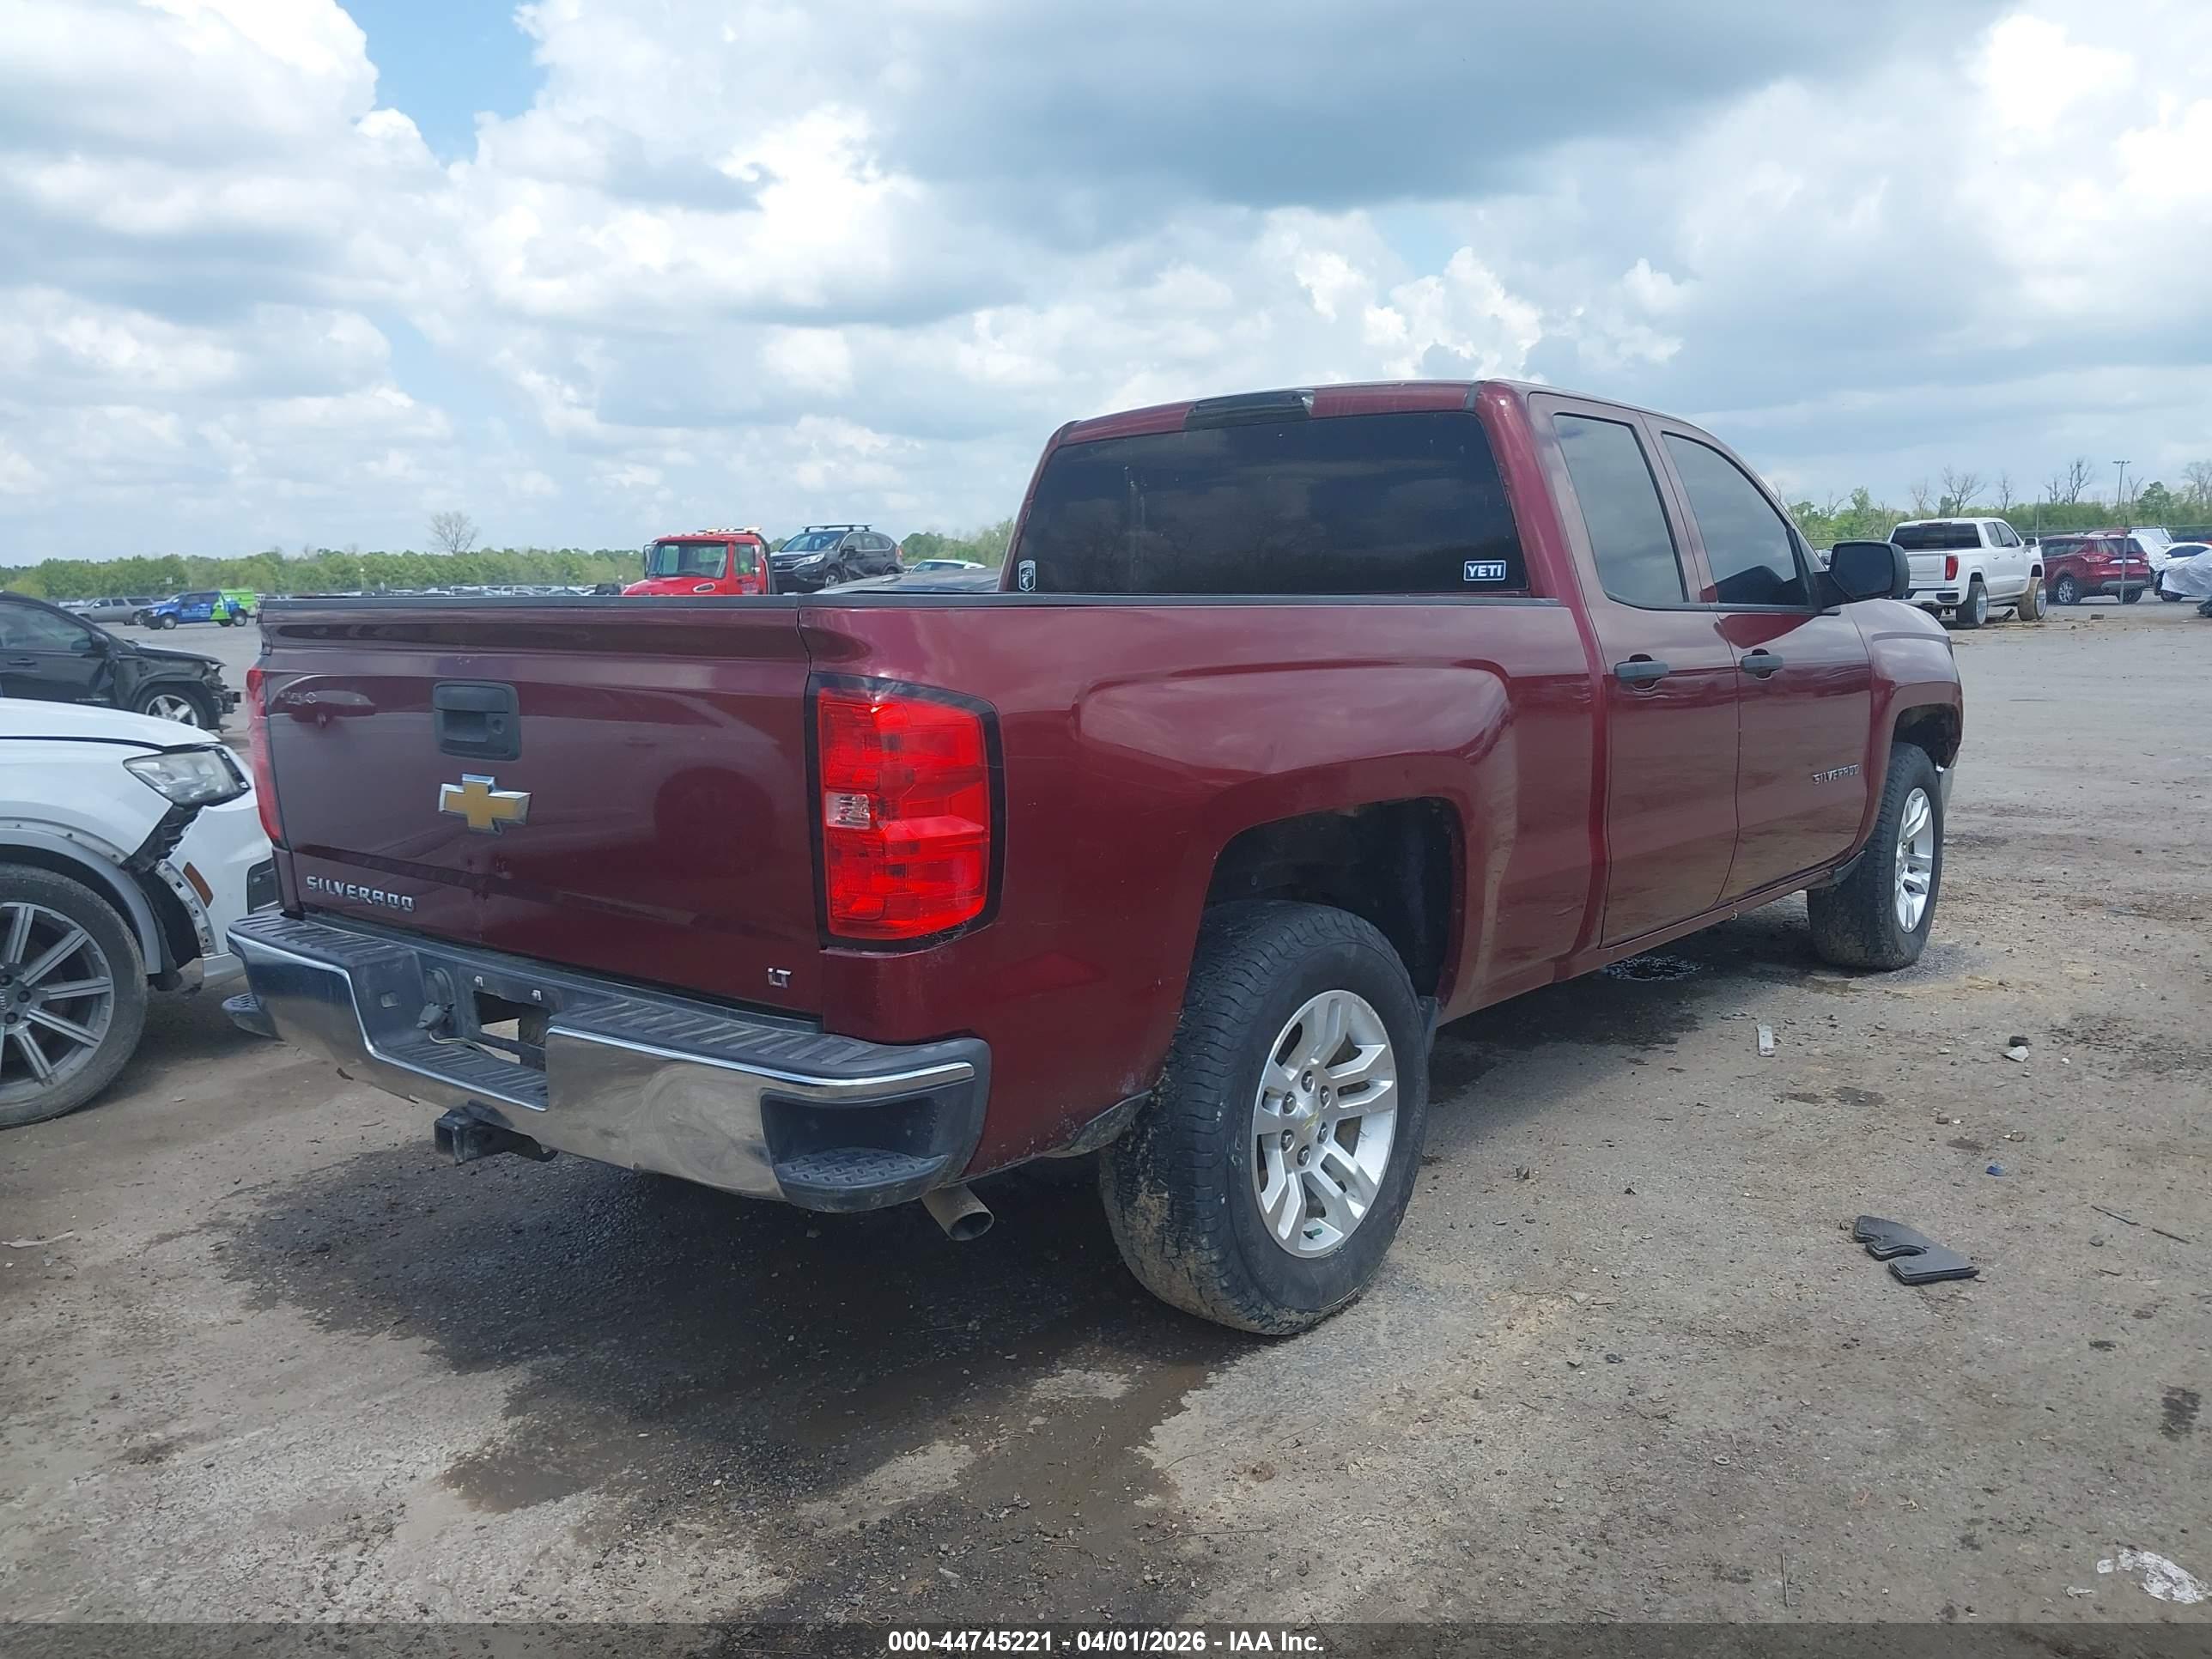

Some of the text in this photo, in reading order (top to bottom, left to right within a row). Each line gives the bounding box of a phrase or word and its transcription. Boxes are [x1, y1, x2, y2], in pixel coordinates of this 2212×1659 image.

[1467, 564, 1504, 578] YETI
[306, 875, 415, 912] SILVERADO
[767, 967, 792, 988] LT
